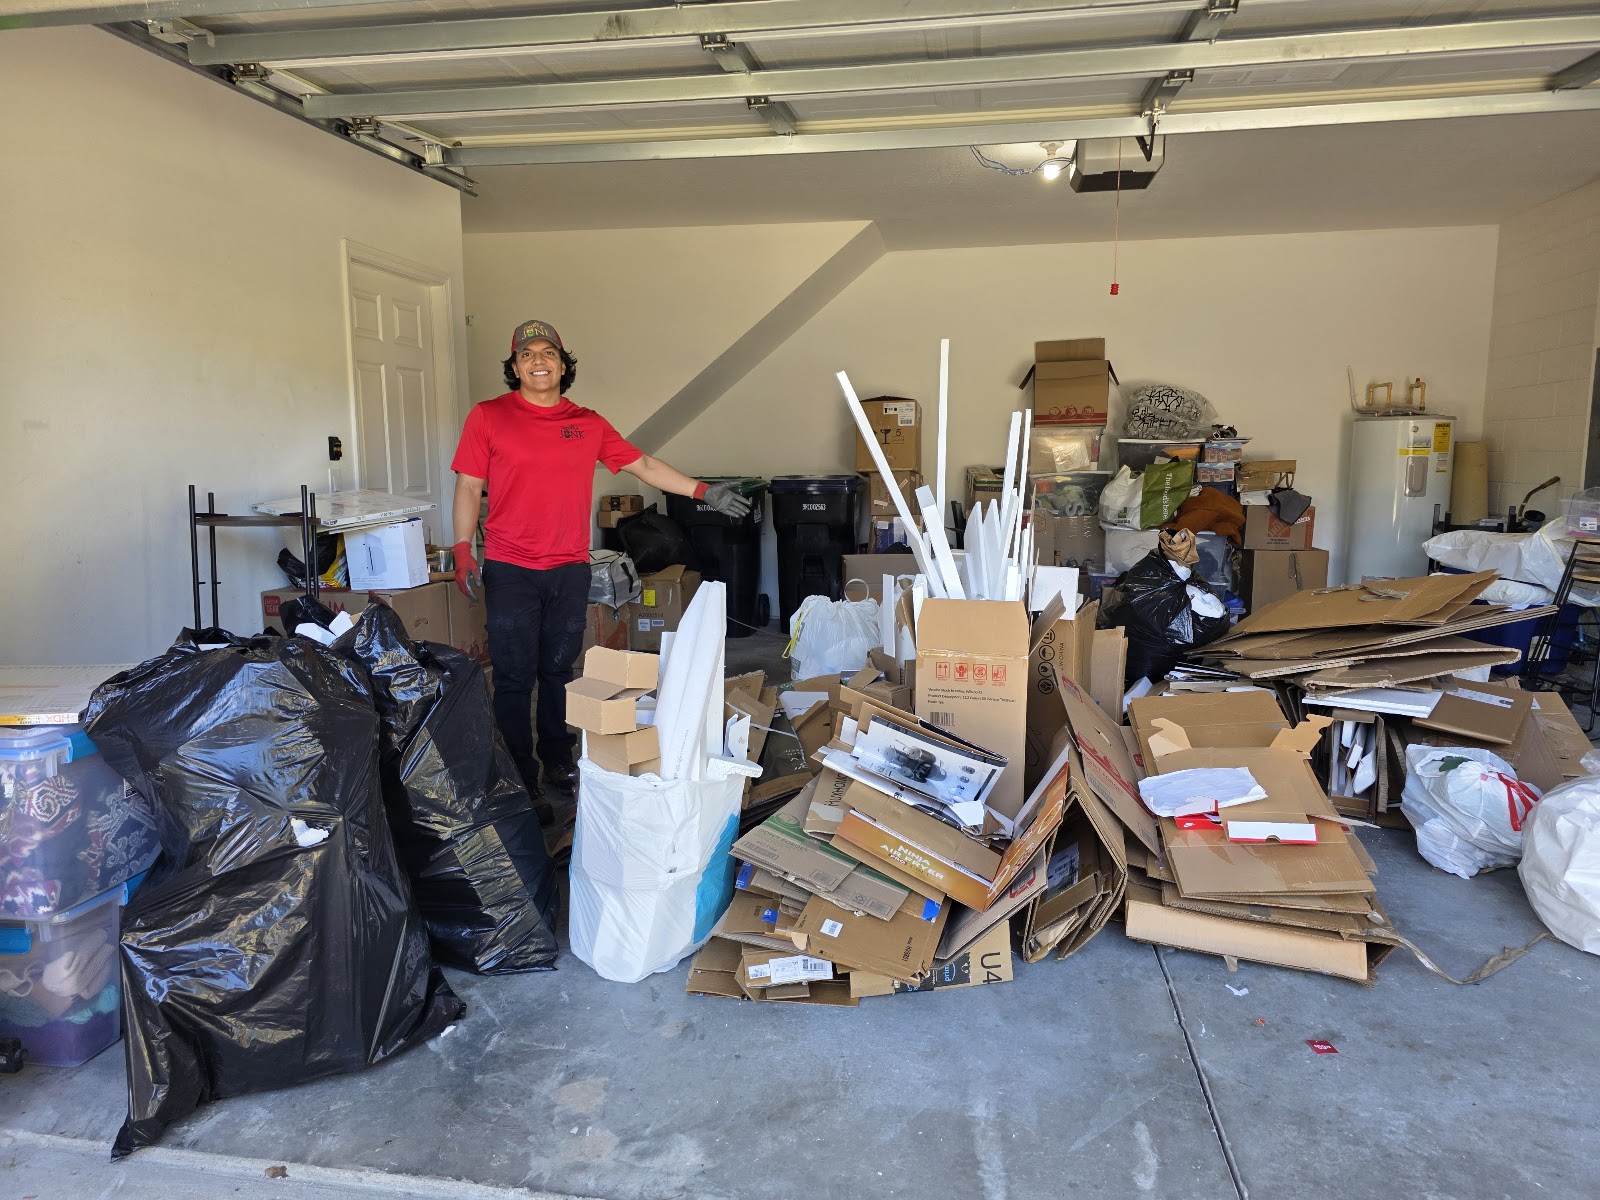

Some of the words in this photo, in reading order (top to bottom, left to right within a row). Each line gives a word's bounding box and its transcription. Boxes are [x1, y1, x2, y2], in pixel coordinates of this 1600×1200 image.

[880, 844, 902, 858] AIR
[904, 857, 944, 880] FRYER
[898, 845, 931, 866] NINJA
